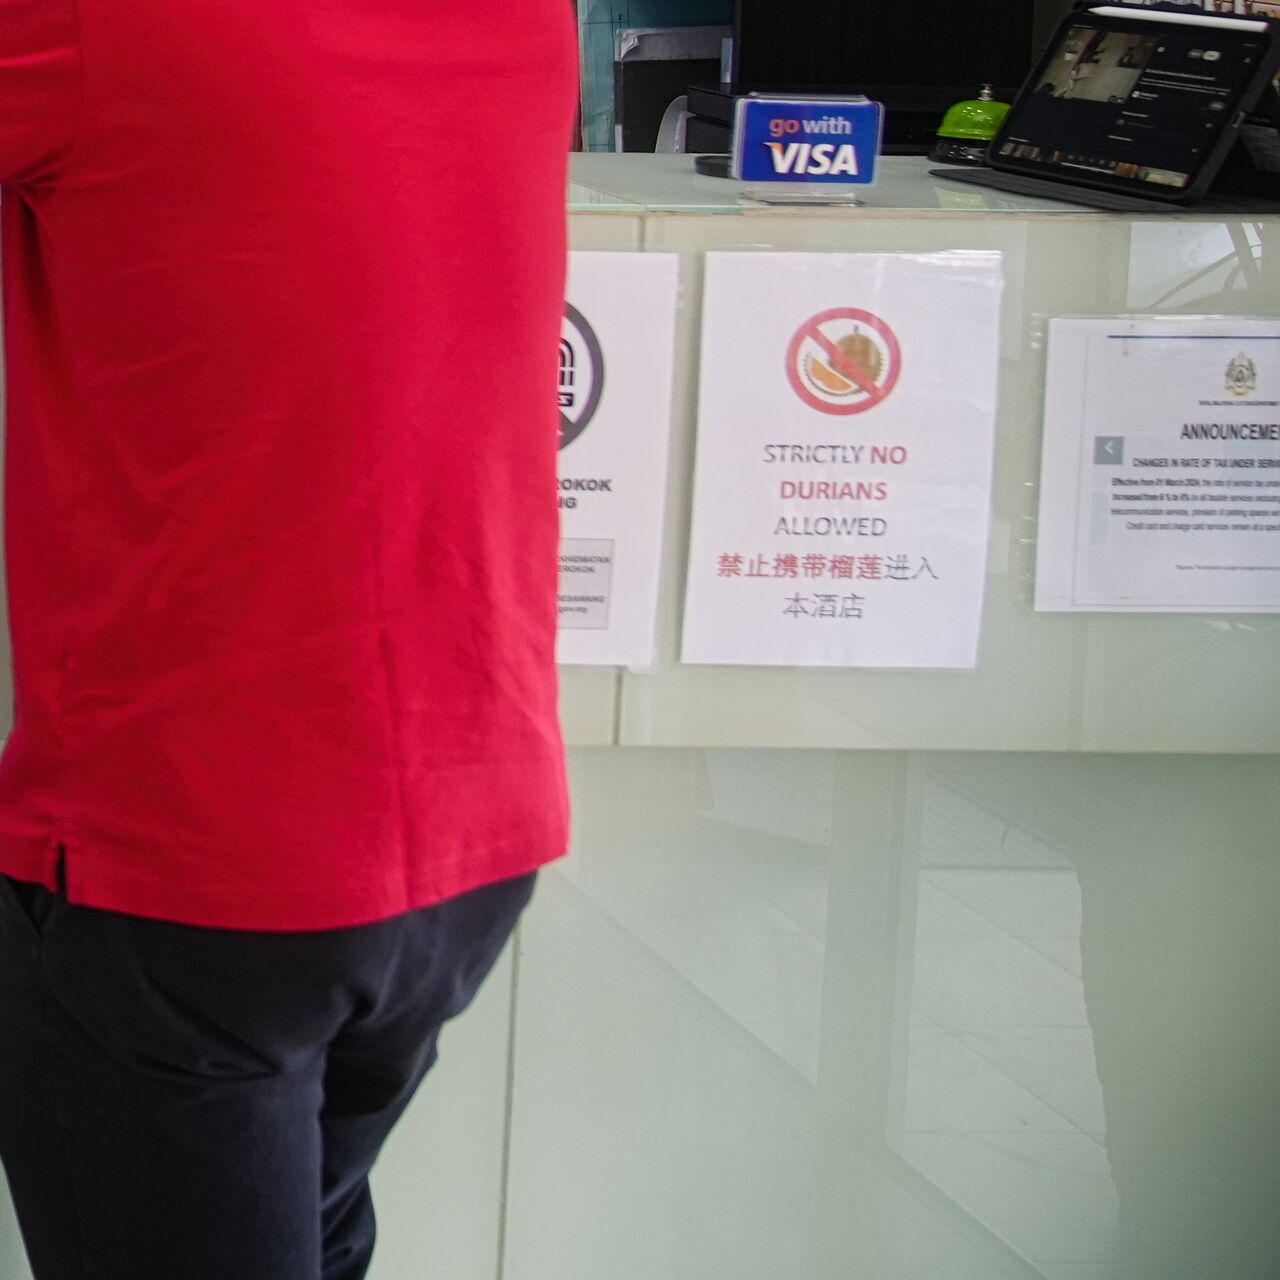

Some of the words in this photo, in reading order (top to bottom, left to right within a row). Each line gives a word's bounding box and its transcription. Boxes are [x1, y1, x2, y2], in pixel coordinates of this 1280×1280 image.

[769, 118, 800, 137] go
[802, 116, 852, 134] with
[763, 142, 858, 175] VISA
[1180, 423, 1280, 440] ANNOUNCEME
[763, 444, 864, 463] STRICTLY
[869, 445, 907, 464] NO
[1133, 458, 1168, 468] CHANGES
[1180, 458, 1199, 468] RATE
[1201, 458, 1212, 468] OF
[557, 478, 612, 491] OKOK
[780, 481, 887, 500] DURIANS
[773, 517, 887, 536] ALLOWED
[717, 553, 938, 580] 禁止携带榴莲进入
[782, 593, 865, 618] 本酒店
